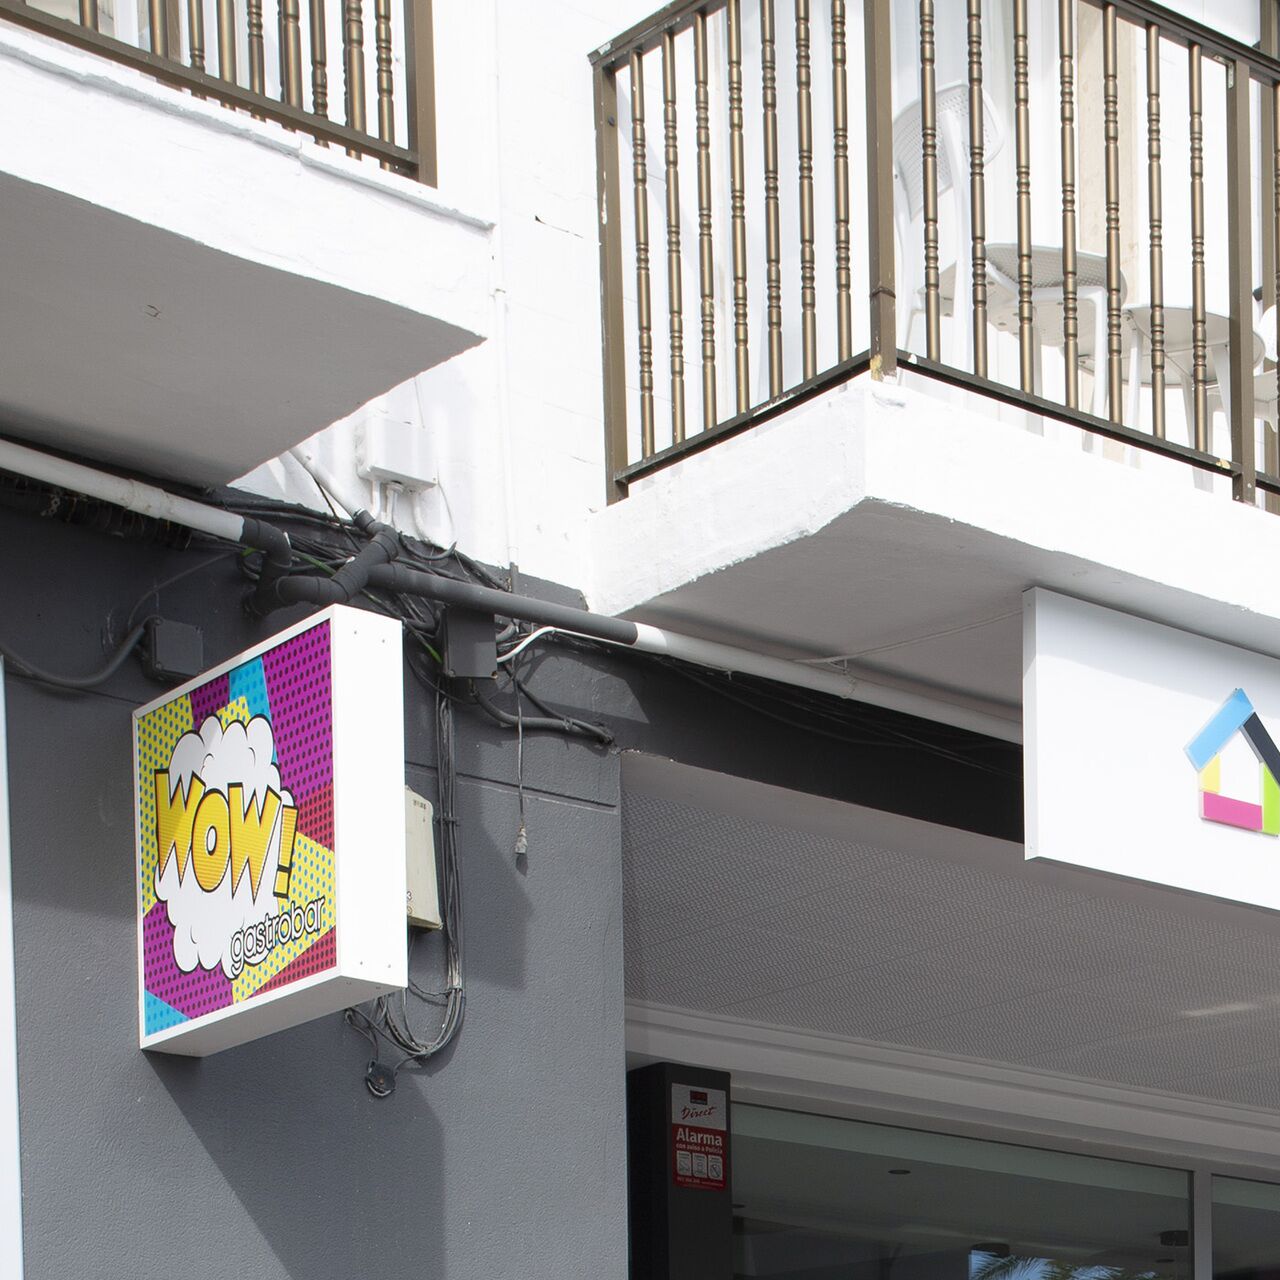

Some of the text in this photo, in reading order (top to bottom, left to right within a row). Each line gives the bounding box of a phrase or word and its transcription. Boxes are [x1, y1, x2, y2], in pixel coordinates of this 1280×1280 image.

[154, 767, 299, 901] WOW!
[229, 895, 327, 976] gastrobar
[676, 1127, 723, 1147] Alarma
